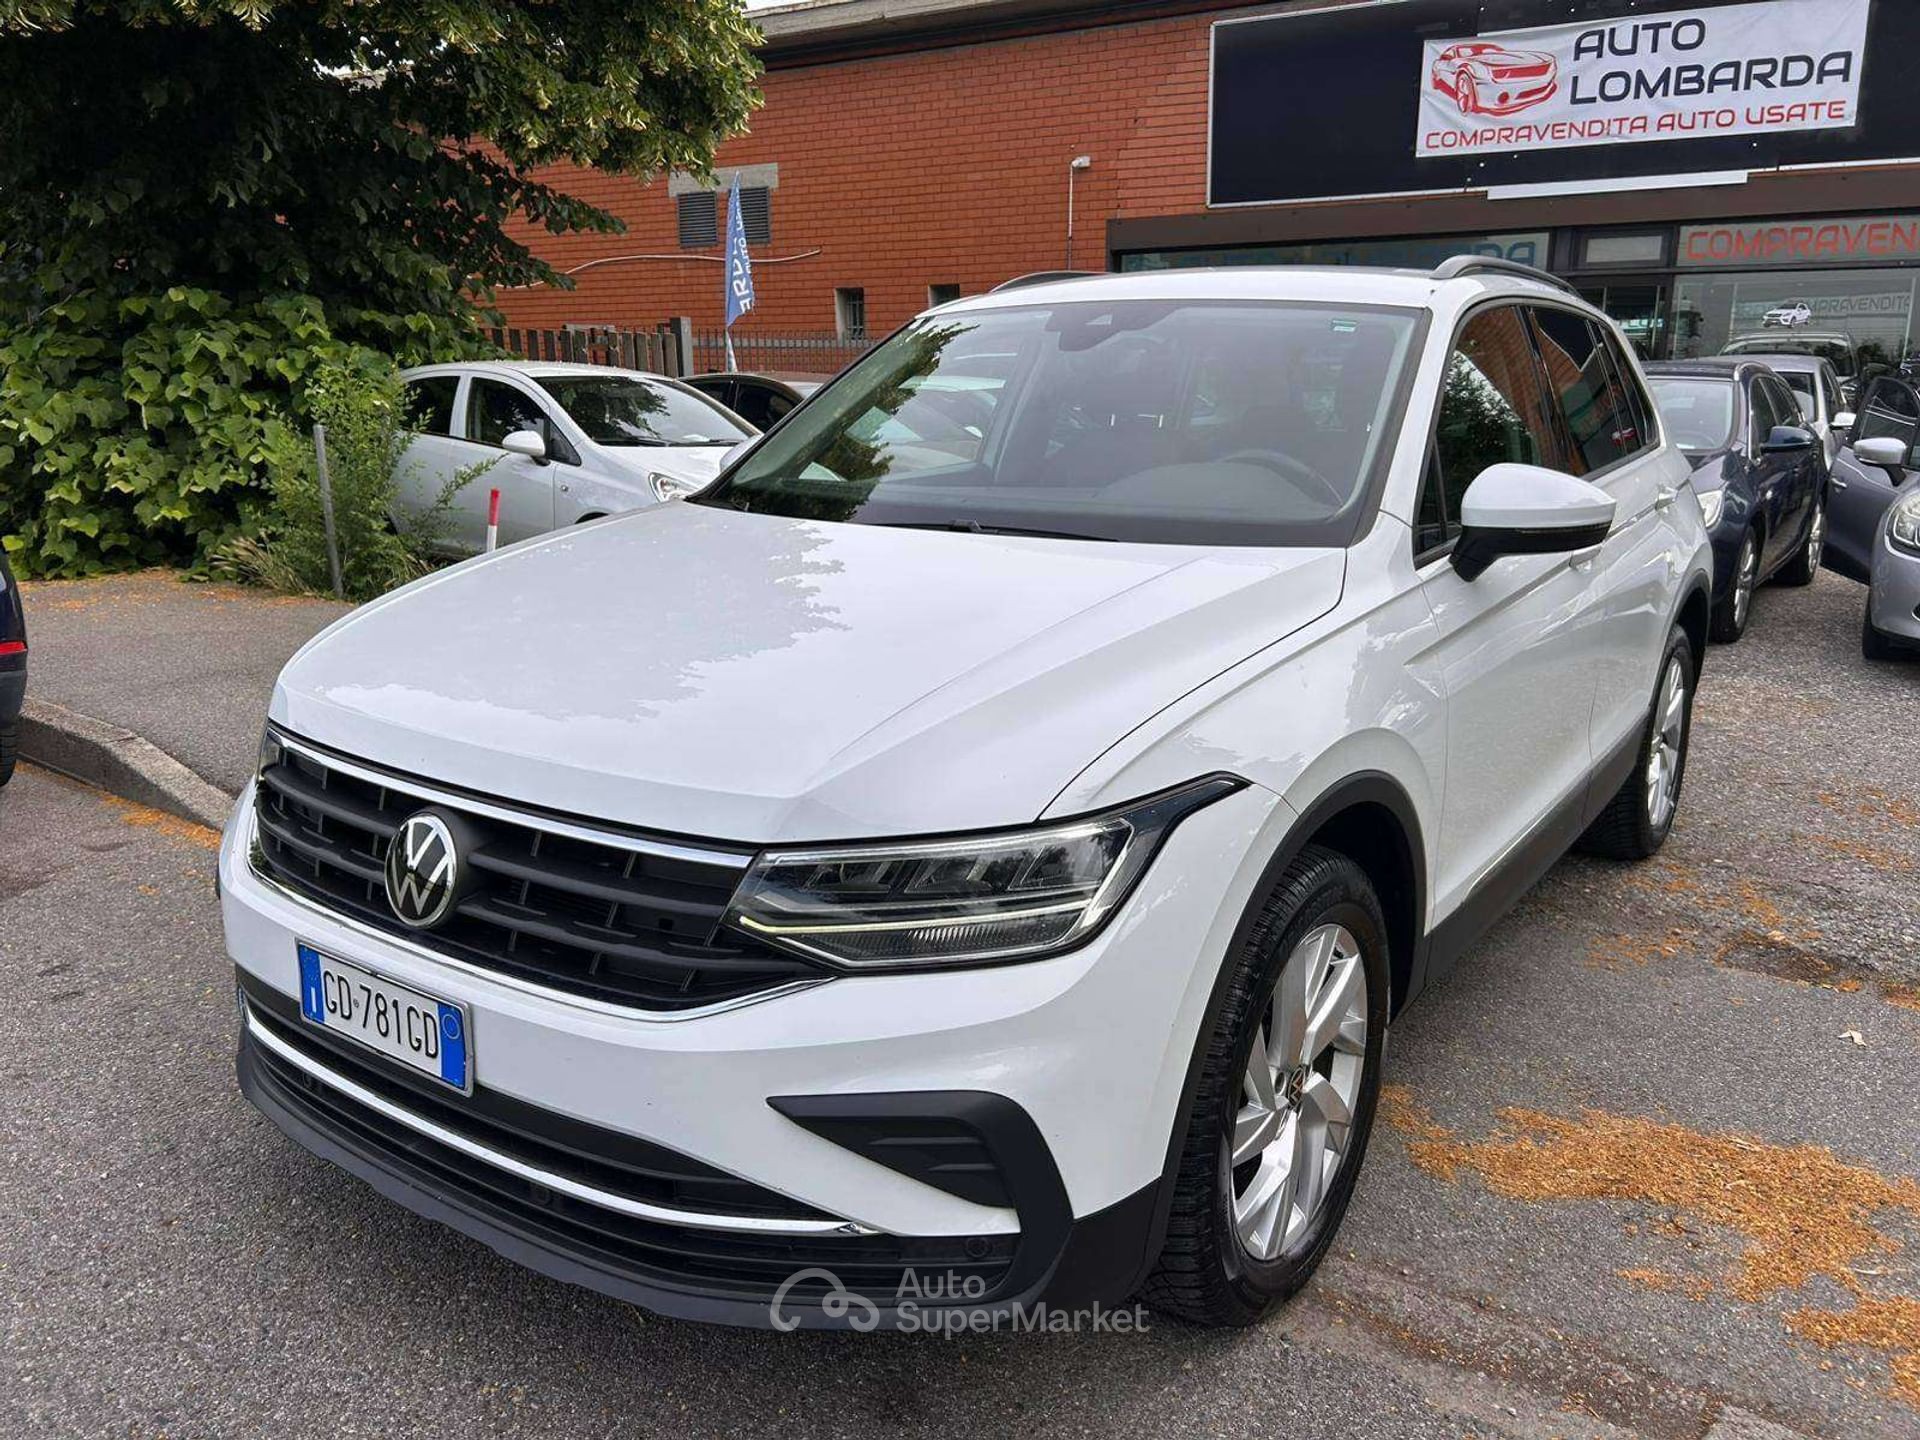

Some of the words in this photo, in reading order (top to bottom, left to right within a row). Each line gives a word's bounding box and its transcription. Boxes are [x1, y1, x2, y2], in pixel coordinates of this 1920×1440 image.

[1573, 18, 1706, 61] AUTO
[1570, 50, 1853, 105] LOMBARDA
[1425, 115, 1648, 149] COMPRAVENDITA
[1656, 108, 1735, 133] AUTO
[1746, 100, 1847, 125] USATE
[1686, 222, 1920, 260] COMPRAVEN
